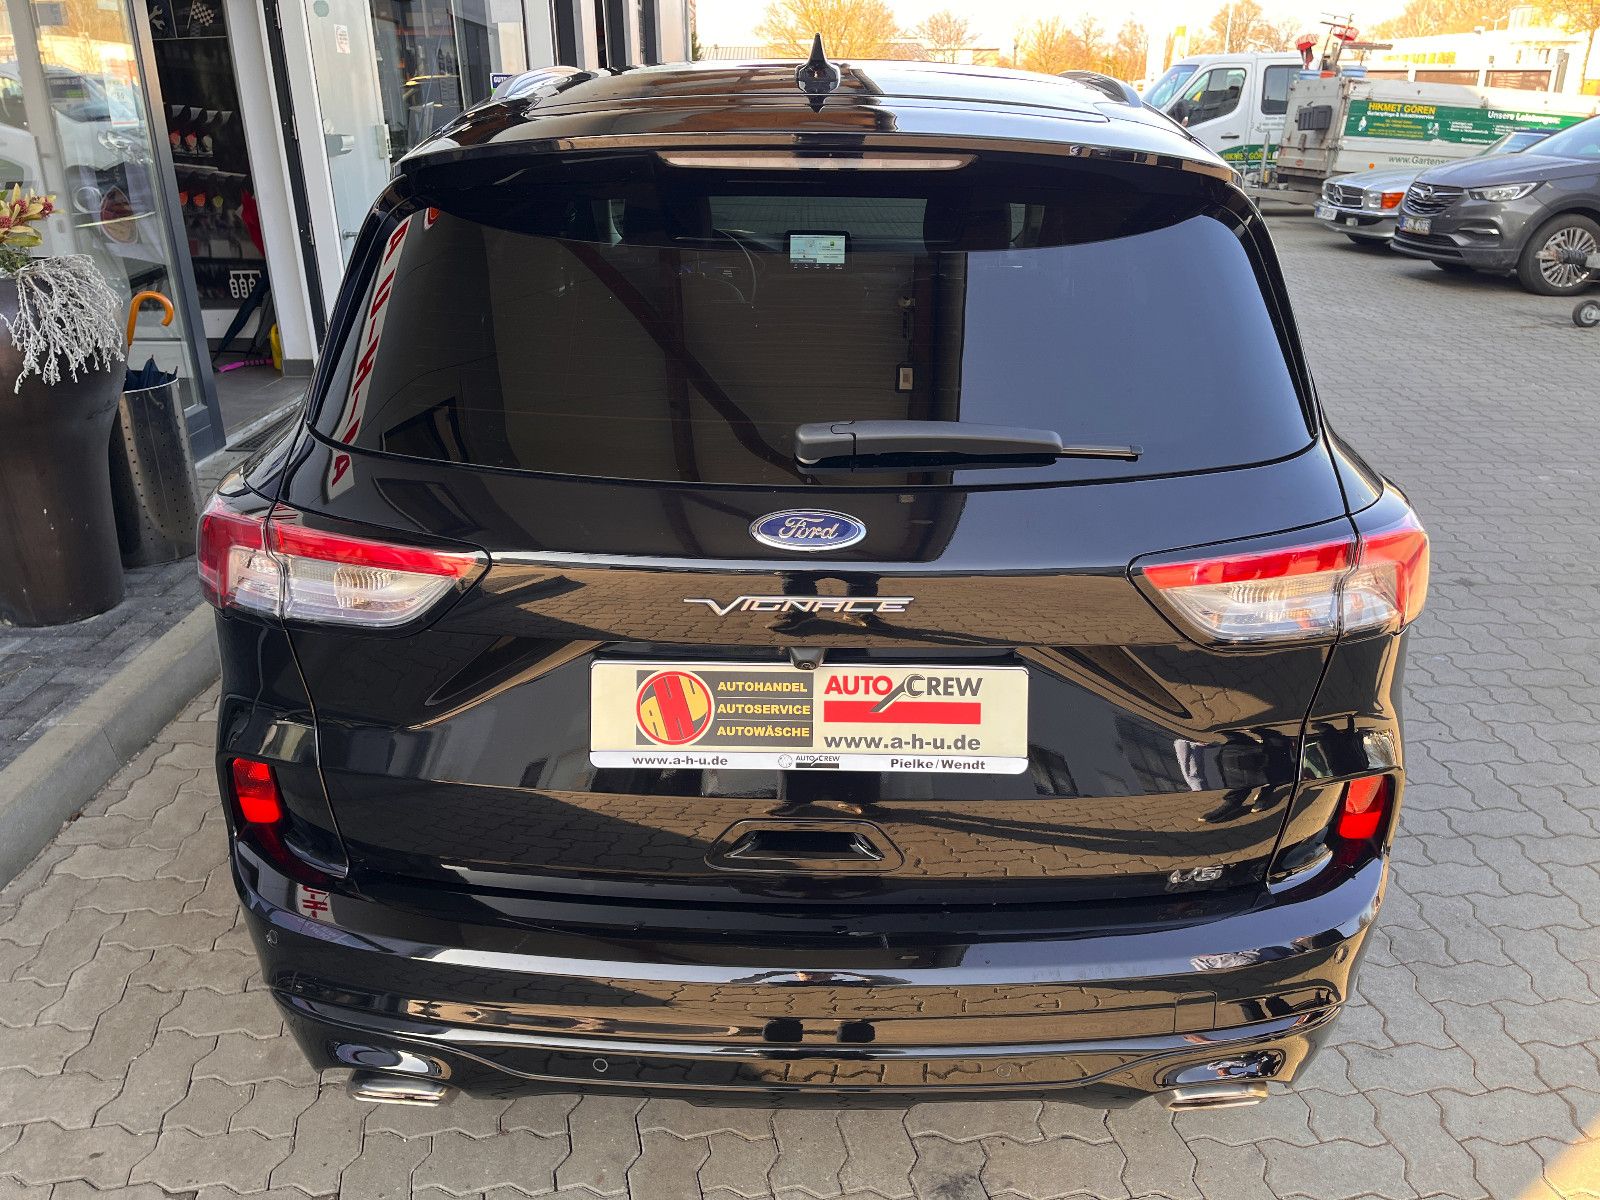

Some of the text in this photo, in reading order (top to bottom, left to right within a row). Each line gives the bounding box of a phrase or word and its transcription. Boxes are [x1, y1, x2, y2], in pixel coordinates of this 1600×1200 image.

[1368, 102, 1403, 112] HIKMET
[778, 517, 840, 540] Ford
[717, 681, 808, 693] AUTOHANDEL
[824, 675, 983, 697] AUTO CREW
[717, 703, 811, 715] AUTOSERVICE
[717, 724, 810, 737] AUTOWÄSCHE
[824, 733, 981, 751] www.a-h-u.de
[632, 756, 728, 767] www.a-h-u.de
[890, 758, 986, 771] Pielke/Wendt
